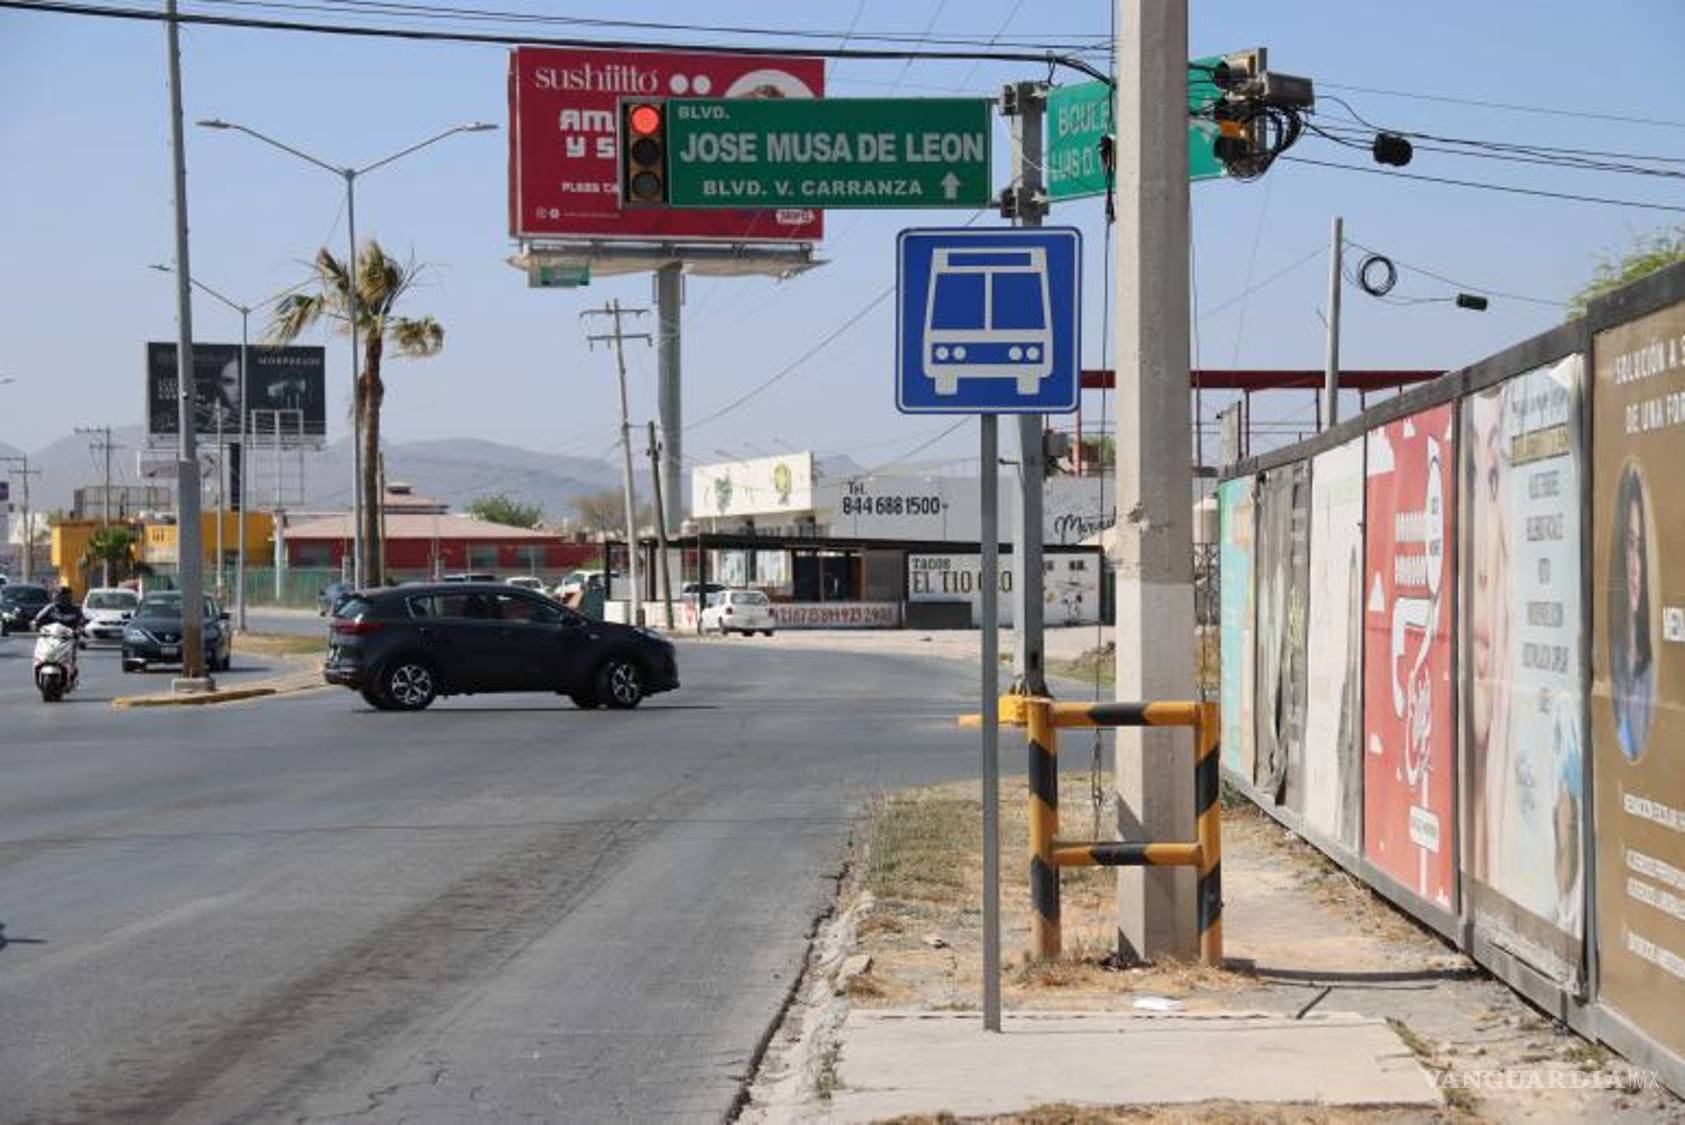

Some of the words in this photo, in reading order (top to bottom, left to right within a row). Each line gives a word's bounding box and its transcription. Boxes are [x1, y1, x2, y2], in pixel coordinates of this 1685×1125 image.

[678, 105, 731, 120] BLVD.
[679, 133, 757, 163] JOSE
[766, 133, 851, 163] MUSA
[858, 133, 897, 163] DE
[906, 133, 984, 163] LEON
[703, 180, 768, 196] BLVD.
[775, 180, 793, 196] V.
[801, 180, 923, 196] CARRANZA
[911, 558, 951, 570] TACOS
[912, 570, 934, 594] EL
